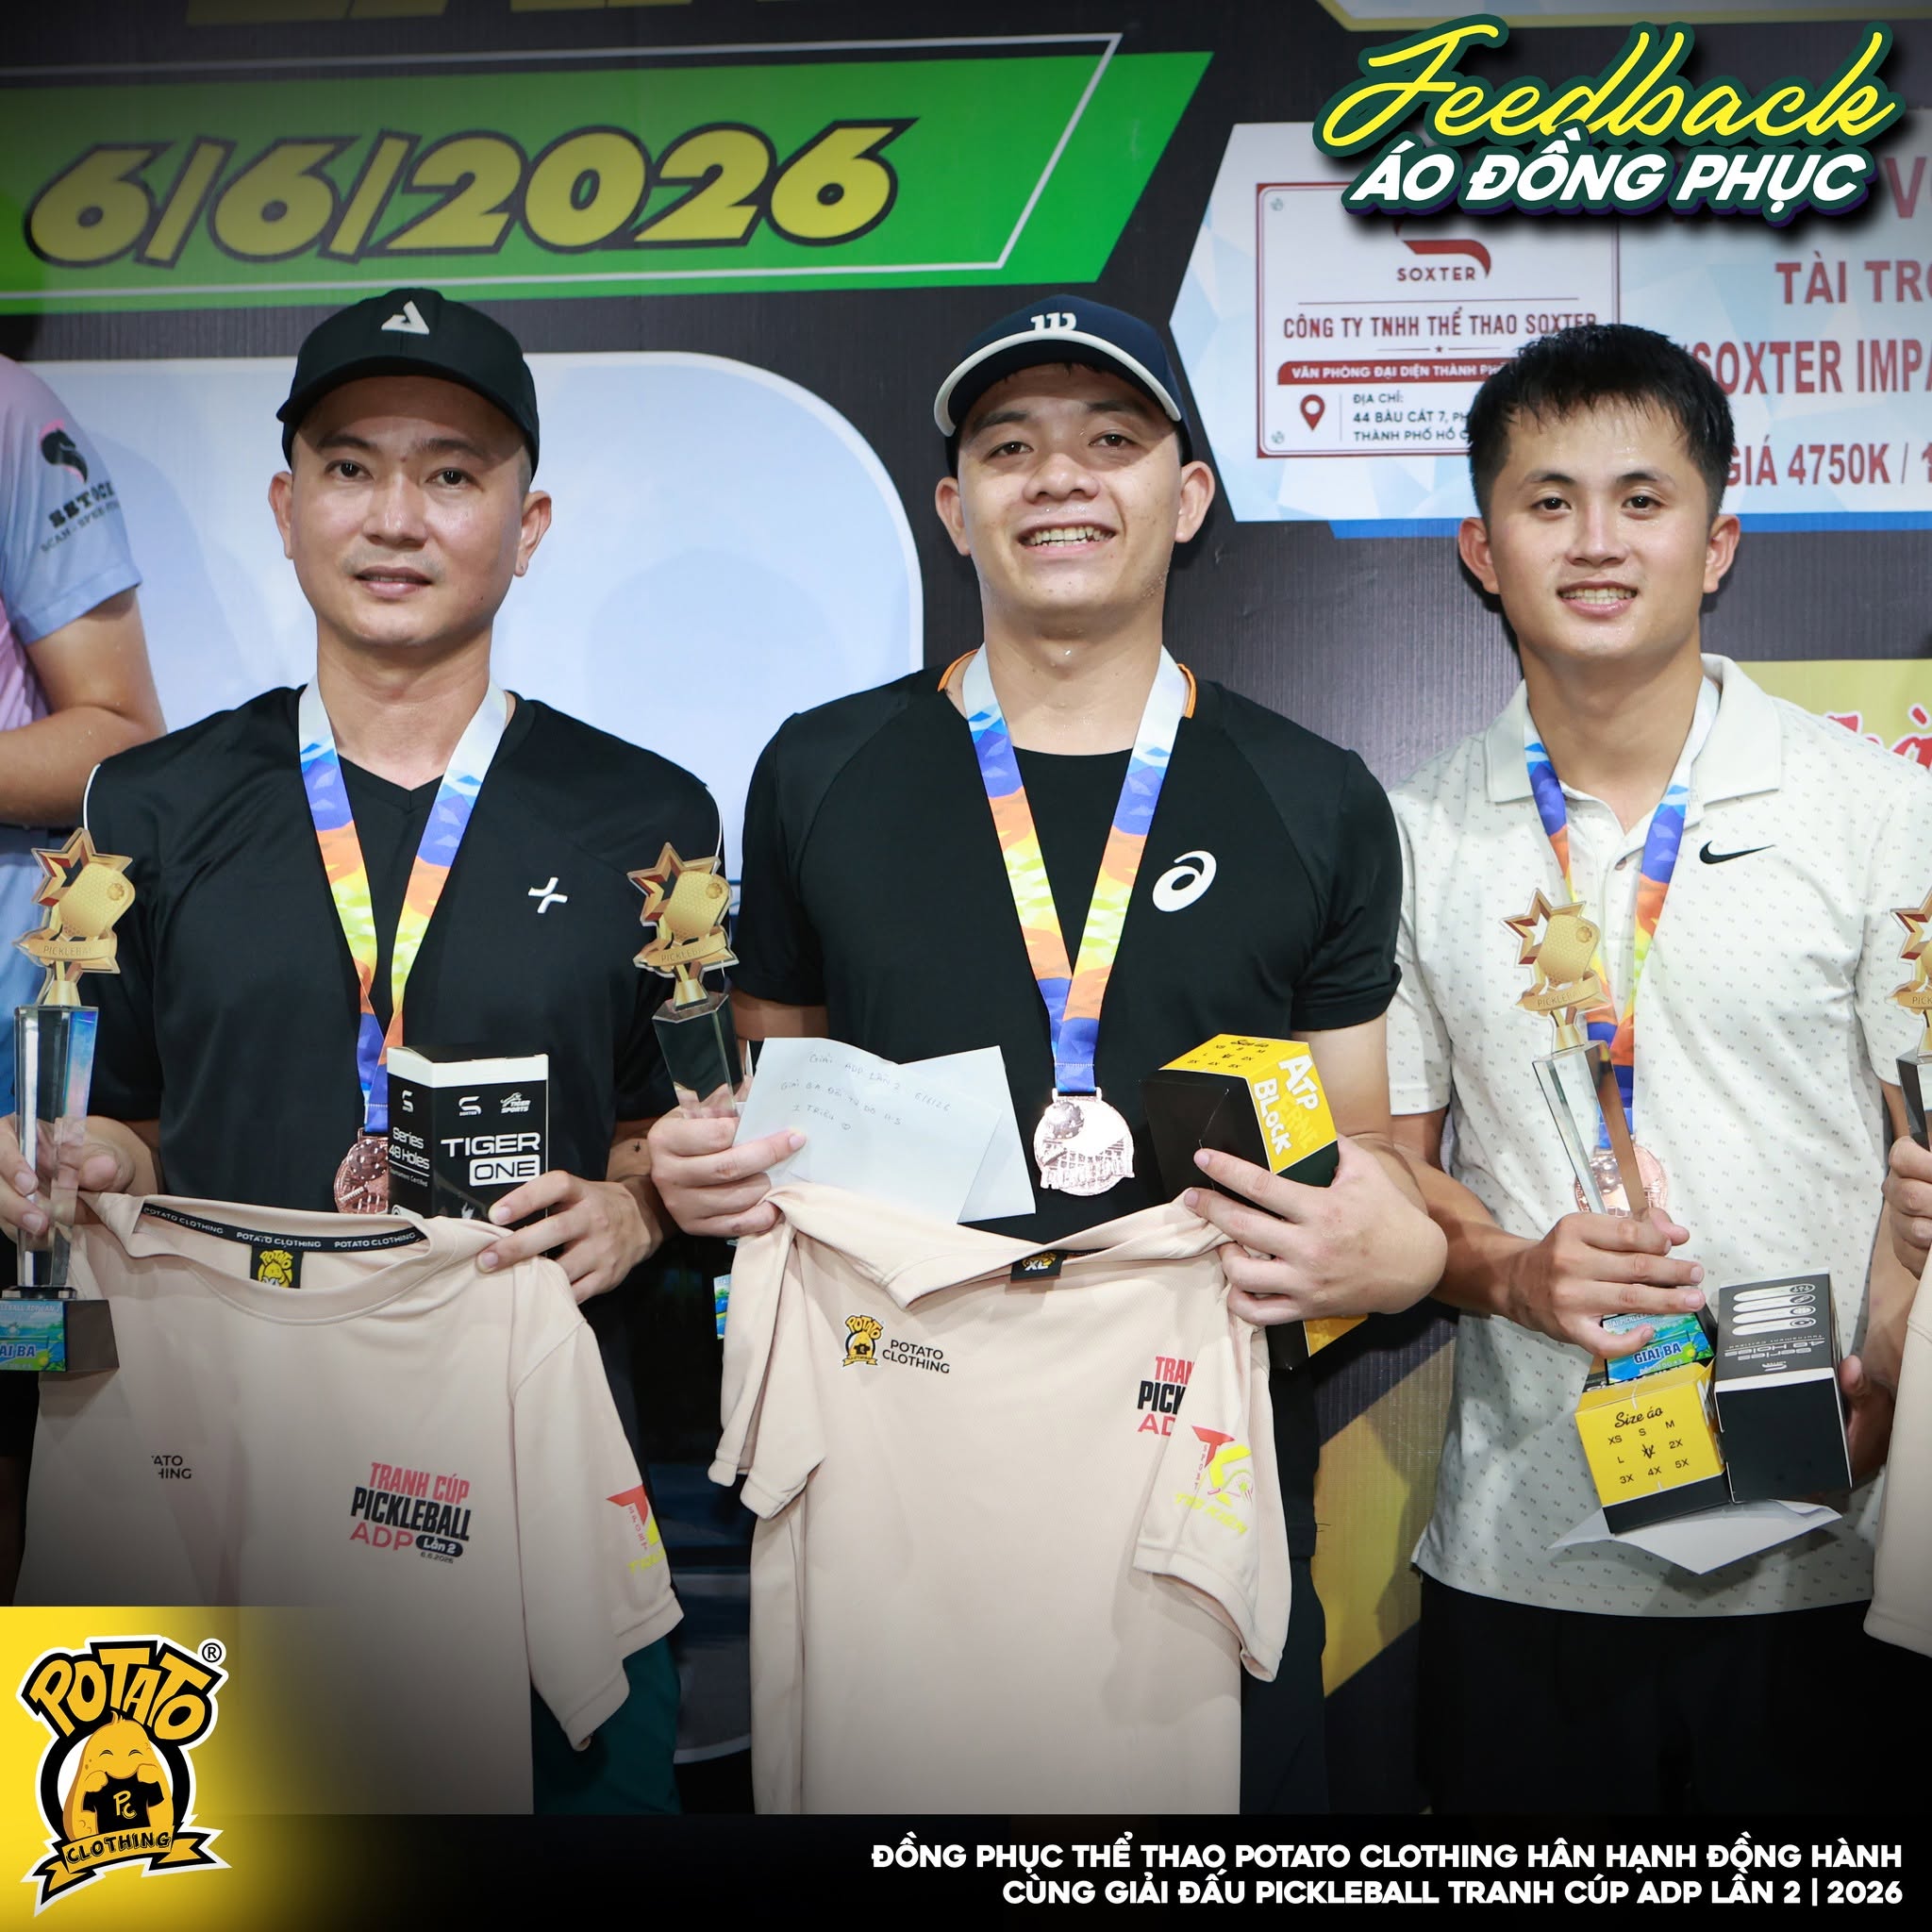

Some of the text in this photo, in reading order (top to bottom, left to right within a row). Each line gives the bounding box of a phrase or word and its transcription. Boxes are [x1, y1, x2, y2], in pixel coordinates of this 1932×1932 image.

[25, 116, 919, 268] 6/6/2026
[1397, 267, 1476, 281] SOXTER
[1774, 250, 1932, 304] TÀI TR
[1284, 313, 1333, 338] CÔNG
[1341, 317, 1362, 338] TY
[1370, 316, 1419, 337] TNHH
[1427, 306, 1461, 336] THỂ
[1469, 314, 1517, 335] THAO
[1291, 365, 1320, 378] VĂN
[1323, 364, 1370, 378] PHÒNG
[1374, 366, 1396, 379] ĐẠI
[1400, 364, 1429, 379] DIỆN
[1433, 363, 1477, 376] THÀNH
[1857, 339, 1932, 392] IMP
[1353, 393, 1374, 405] ĐỊA
[1353, 412, 1370, 423] 44
[1374, 408, 1403, 423] BÀU
[1407, 408, 1434, 423] CÁT
[1354, 428, 1399, 441] THÀNH
[1404, 426, 1432, 441] PHỐ
[1788, 443, 1890, 486] 4750K
[1277, 1054, 1319, 1109] ATP
[392, 1126, 424, 1149] Series
[441, 1132, 541, 1158] TIGER
[389, 1144, 430, 1170] 48 Holes
[475, 1160, 536, 1180] ONE
[143, 1208, 224, 1234] POTATO CLOTHING
[236, 1232, 322, 1248] POTATO CLOTHING
[334, 1232, 416, 1248] POTATO CLOTHING
[1024, 1259, 1049, 1271] XL
[845, 1315, 883, 1340] POTATO
[16, 1344, 36, 1357] BA
[891, 1340, 943, 1359] POTATO
[1633, 1342, 1682, 1363] GIẢI BA
[882, 1350, 950, 1374] CLOTHING
[1614, 1406, 1663, 1428] Size áo
[1607, 1435, 1623, 1445] XS
[1665, 1420, 1675, 1428] M
[151, 1456, 183, 1466] ATO
[1617, 1456, 1624, 1464] L
[1669, 1439, 1683, 1449] 2X
[1620, 1458, 1690, 1484] 3X 4X 5X
[369, 1462, 470, 1505] TRANH CÚP
[350, 1486, 471, 1541] PICKLEBALL
[349, 1522, 457, 1554] ADP Lần 2
[421, 1551, 454, 1564] 6.6.2026
